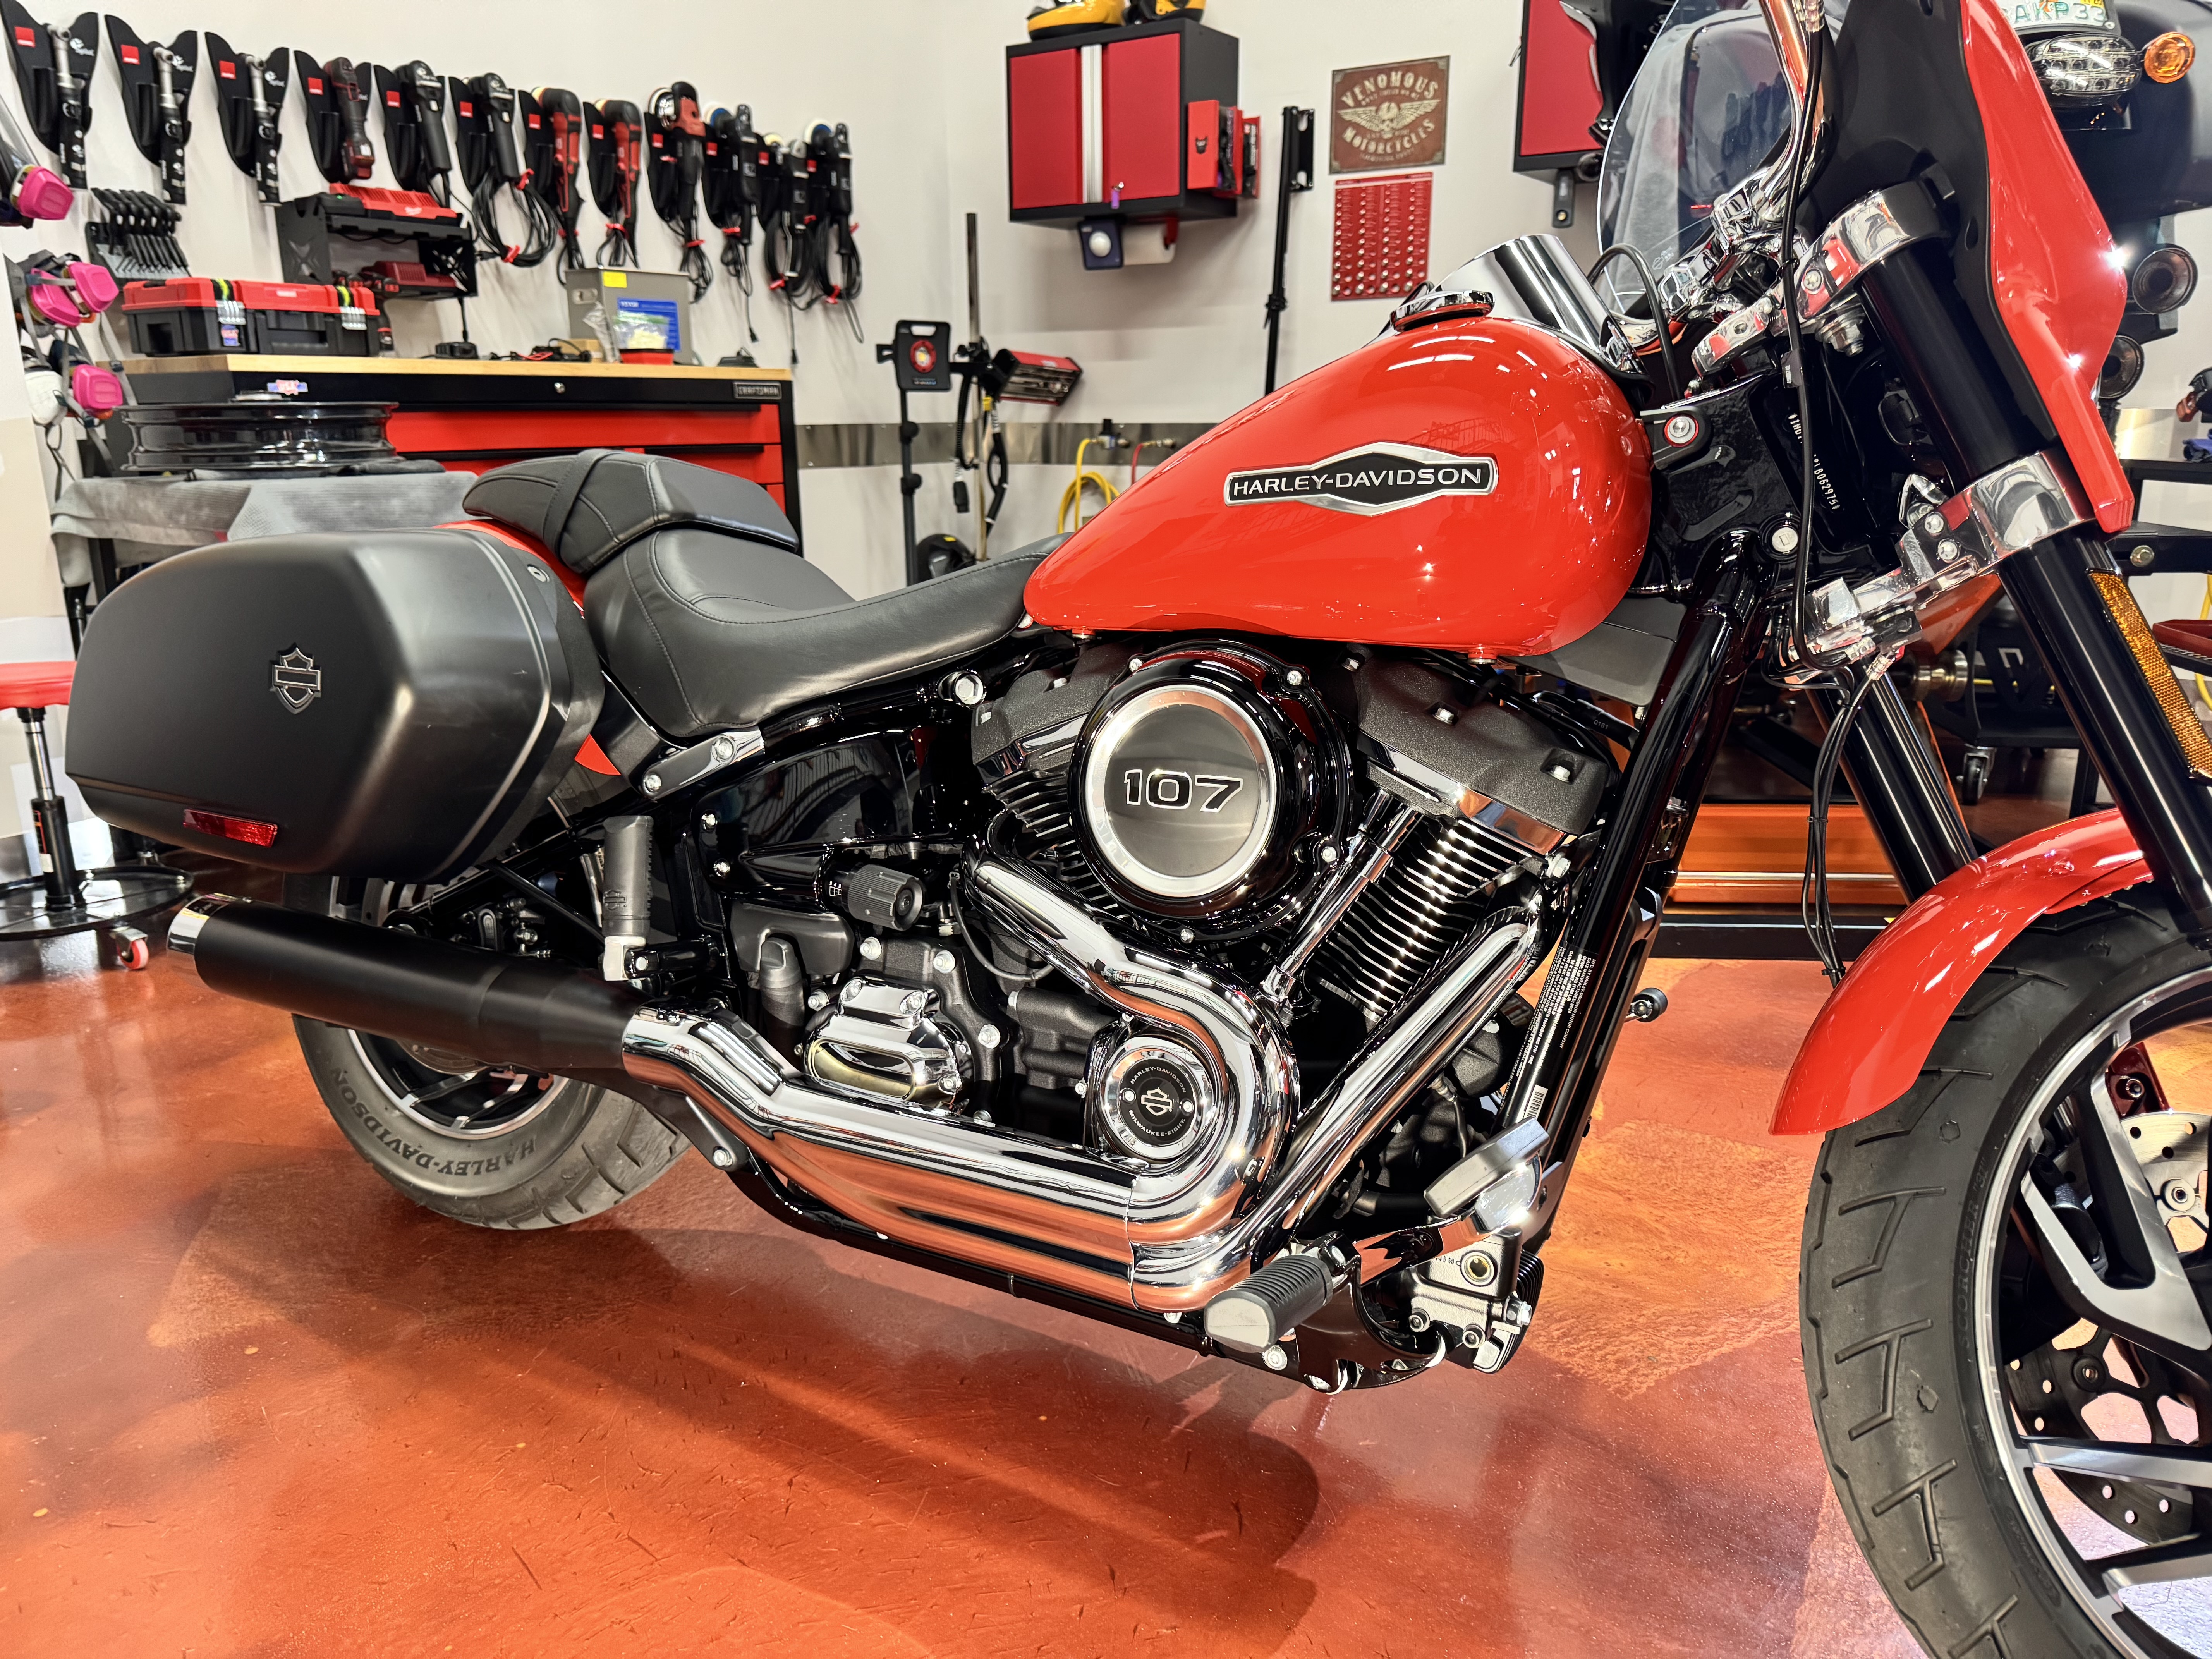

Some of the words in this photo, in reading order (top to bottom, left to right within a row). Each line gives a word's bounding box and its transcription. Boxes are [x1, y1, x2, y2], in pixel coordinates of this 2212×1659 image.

[1341, 71, 1438, 108] VENOMOUS
[1343, 119, 1435, 155] MOTORCYCLES
[1233, 468, 1482, 496] HARLEY-DAVIDSON
[1123, 769, 1244, 813] 107
[1571, 968, 1587, 1003] MANUFACTURED:
[1572, 975, 1590, 1013] HARLEY-DAVIDSON
[1551, 1003, 1559, 1015] COLD
[1567, 1013, 1575, 1029] MOTOR
[1559, 1028, 1570, 1049] COMPANY
[1130, 1066, 1187, 1093] HARLEY-DAVIDSON
[335, 1068, 537, 1176] HARLEY-DAVIDSON
